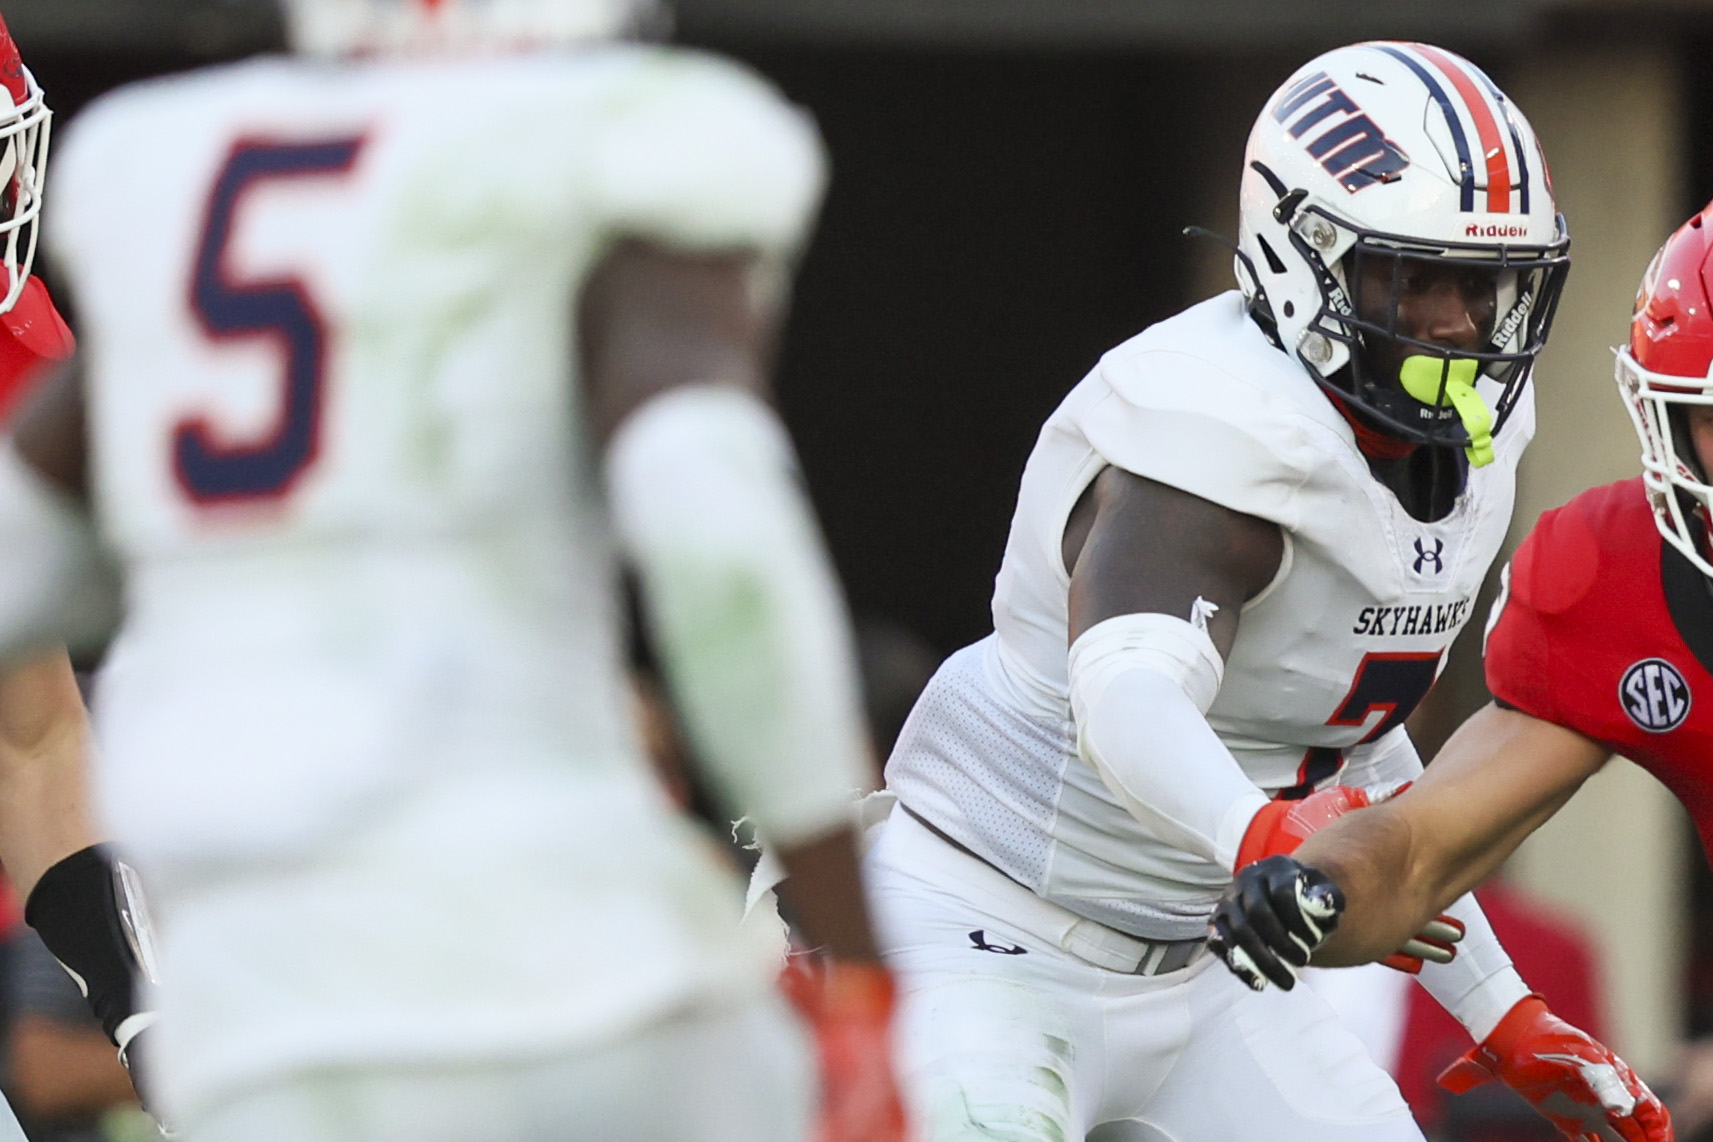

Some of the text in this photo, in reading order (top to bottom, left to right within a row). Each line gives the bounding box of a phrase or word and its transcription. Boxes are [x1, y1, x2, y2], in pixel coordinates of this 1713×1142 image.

[1271, 71, 1411, 195] UTM
[169, 129, 371, 507] 5
[1490, 290, 1533, 349] Riddell
[1272, 644, 1447, 801] 7
[1625, 663, 1686, 727] SEC
